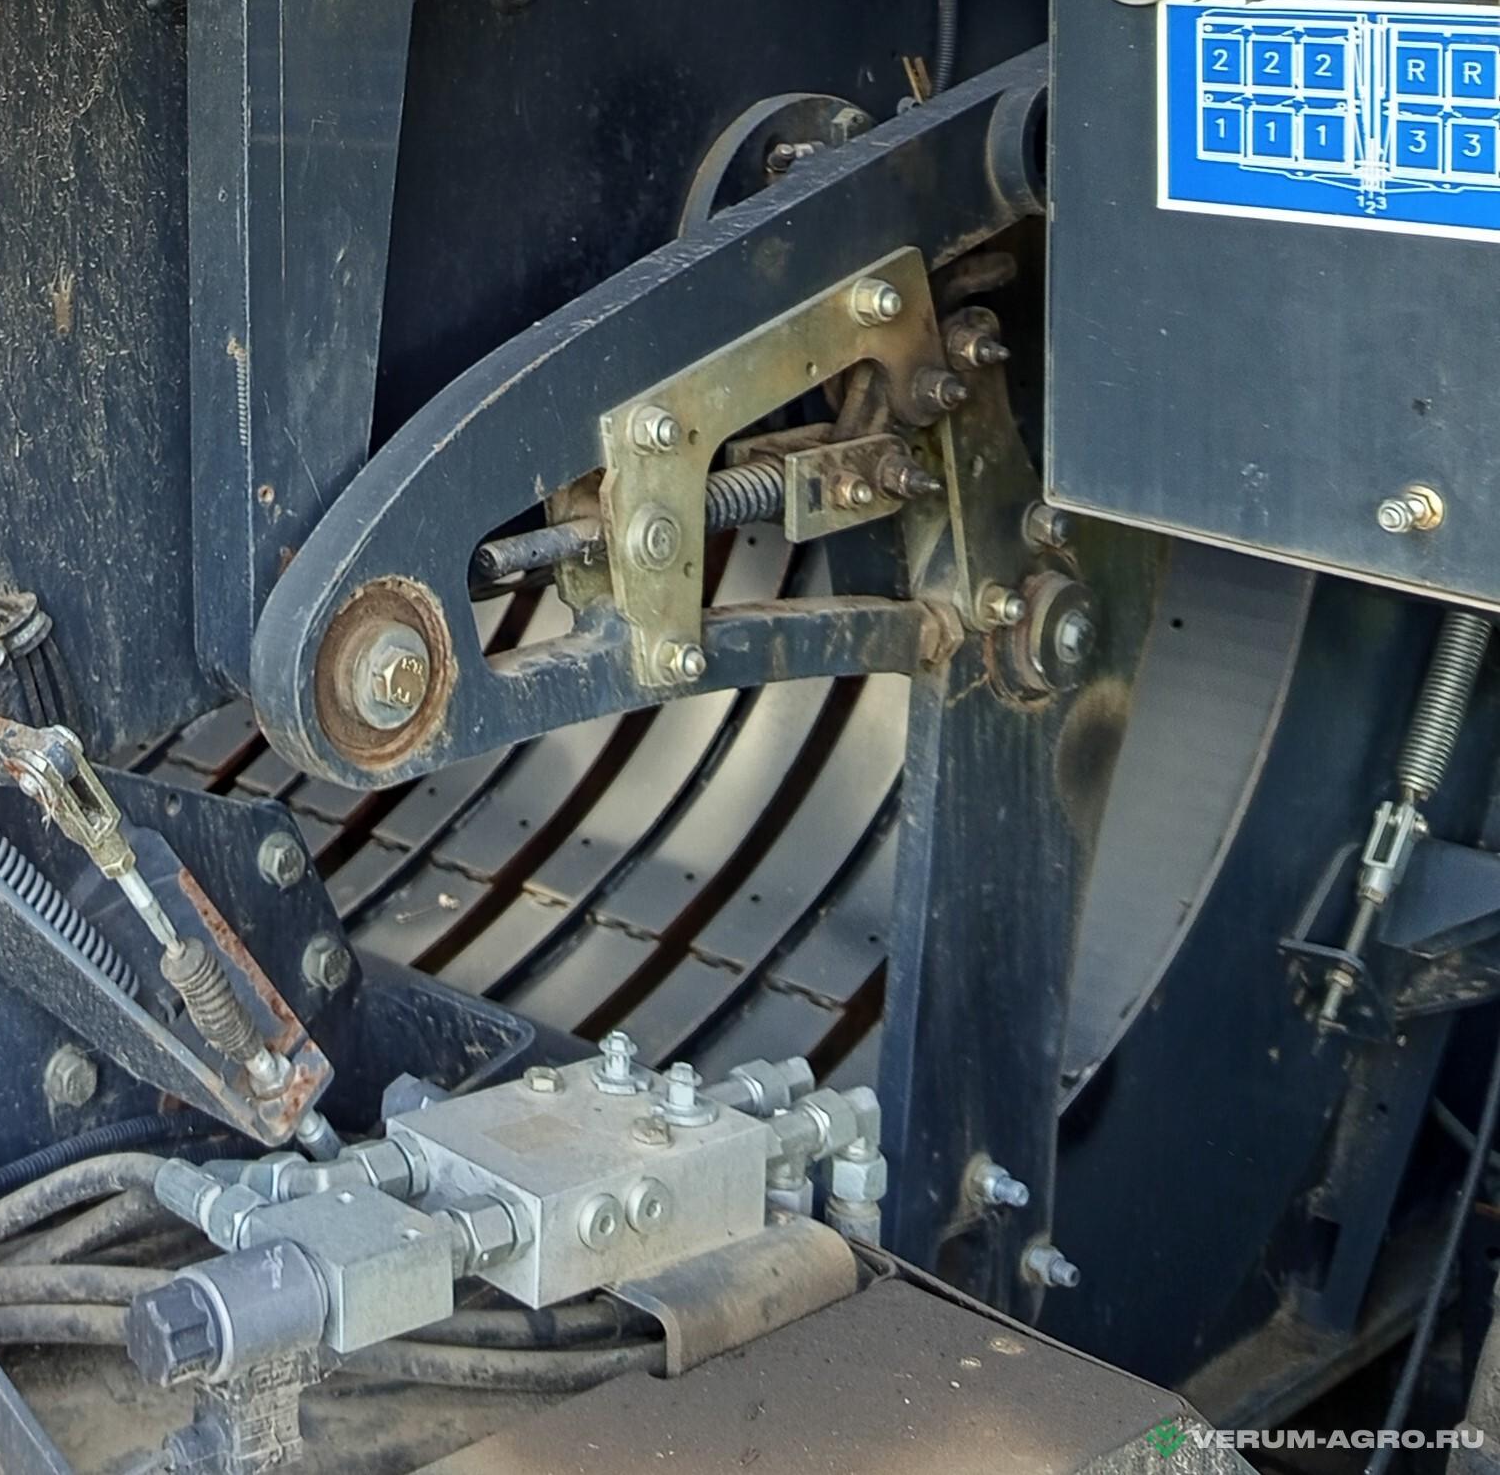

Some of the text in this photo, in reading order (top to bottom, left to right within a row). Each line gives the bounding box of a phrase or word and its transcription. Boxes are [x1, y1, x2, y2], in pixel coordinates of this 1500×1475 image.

[1212, 48, 1332, 76] 2 2 2
[1407, 58, 1482, 85] R R
[1216, 117, 1327, 146] 1 1 1
[1408, 129, 1481, 157] 3 3
